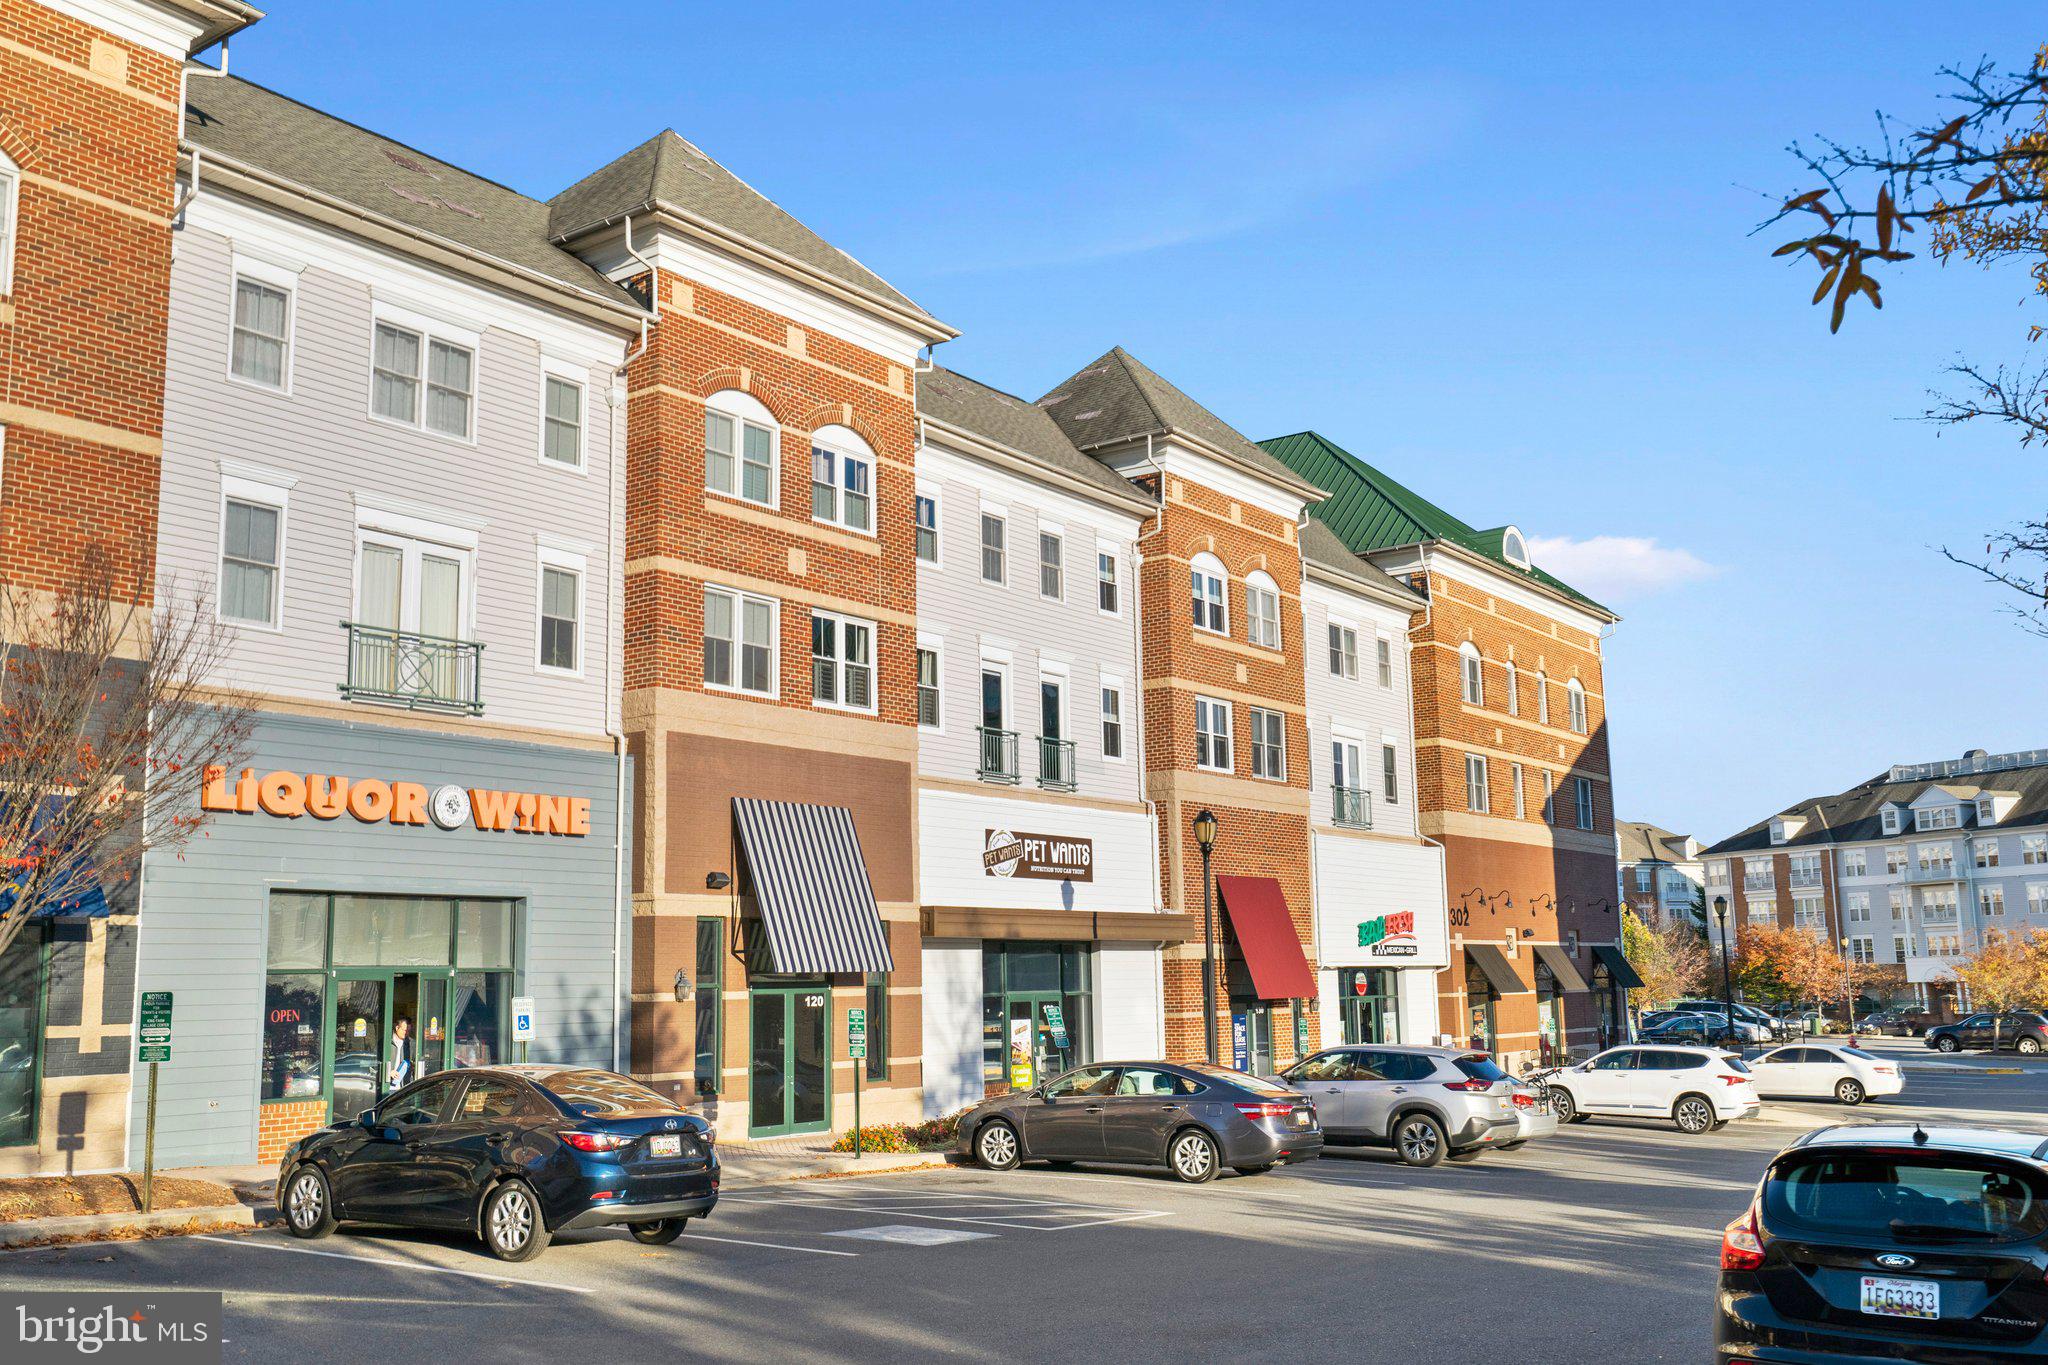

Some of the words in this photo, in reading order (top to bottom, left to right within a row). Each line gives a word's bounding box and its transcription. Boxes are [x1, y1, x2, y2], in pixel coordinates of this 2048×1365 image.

[202, 765, 429, 824] LIQUOR
[468, 789, 591, 834] WINE
[984, 851, 998, 866] PET
[997, 844, 1021, 860] WANTS
[1024, 839, 1047, 863] PET
[1050, 842, 1090, 866] WANTS
[1384, 910, 1414, 936] FRESH
[1450, 908, 1470, 926] 302
[805, 996, 824, 1007] 120
[271, 1009, 300, 1023] OPEN
[1885, 1256, 1905, 1265] Ford
[1981, 1316, 2038, 1328] TITANIUM
